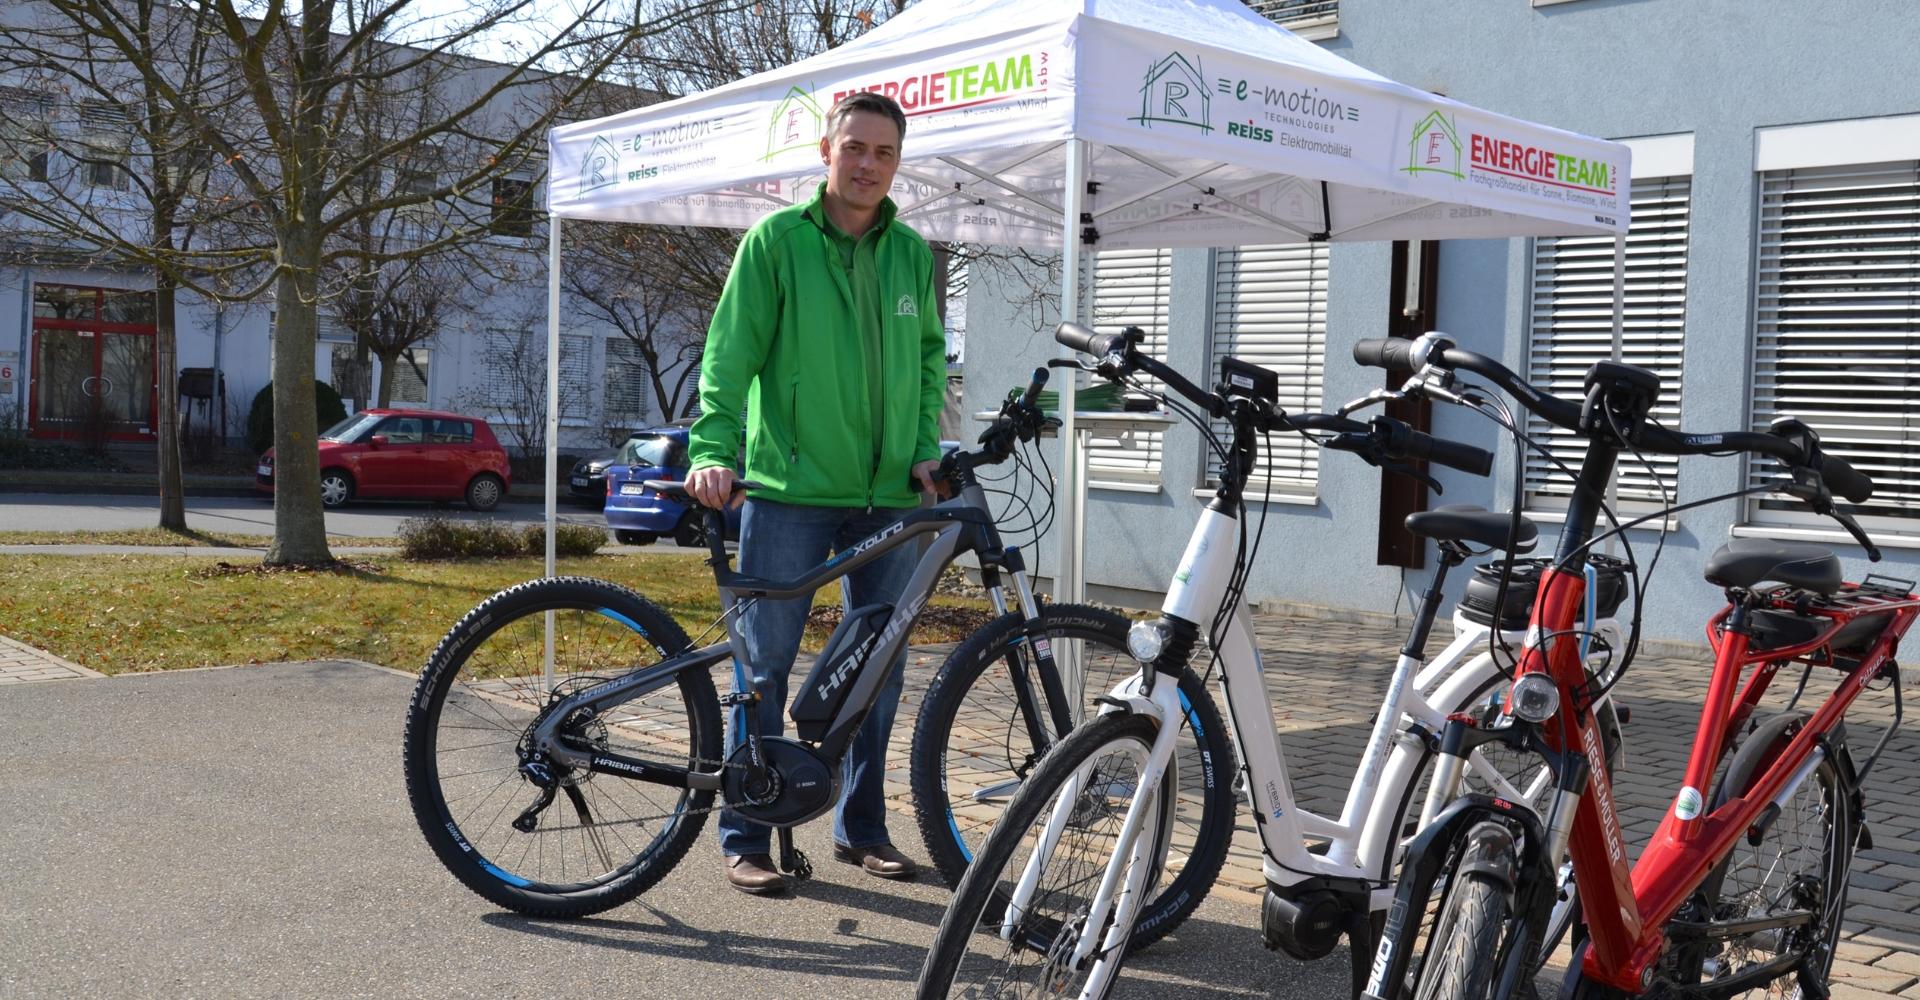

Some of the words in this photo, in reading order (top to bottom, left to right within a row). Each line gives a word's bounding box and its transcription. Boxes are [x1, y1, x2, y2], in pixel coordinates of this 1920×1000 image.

[834, 54, 1033, 110] RGIETEAM
[1264, 112, 1335, 133] TECHNOLOGIES
[1280, 132, 1352, 158] Elektromobilität
[1471, 134, 1608, 189] ENERGIETEAM
[2, 367, 12, 379] 6
[1205, 765, 1215, 789] SWISS
[445, 822, 463, 842] SWISS
